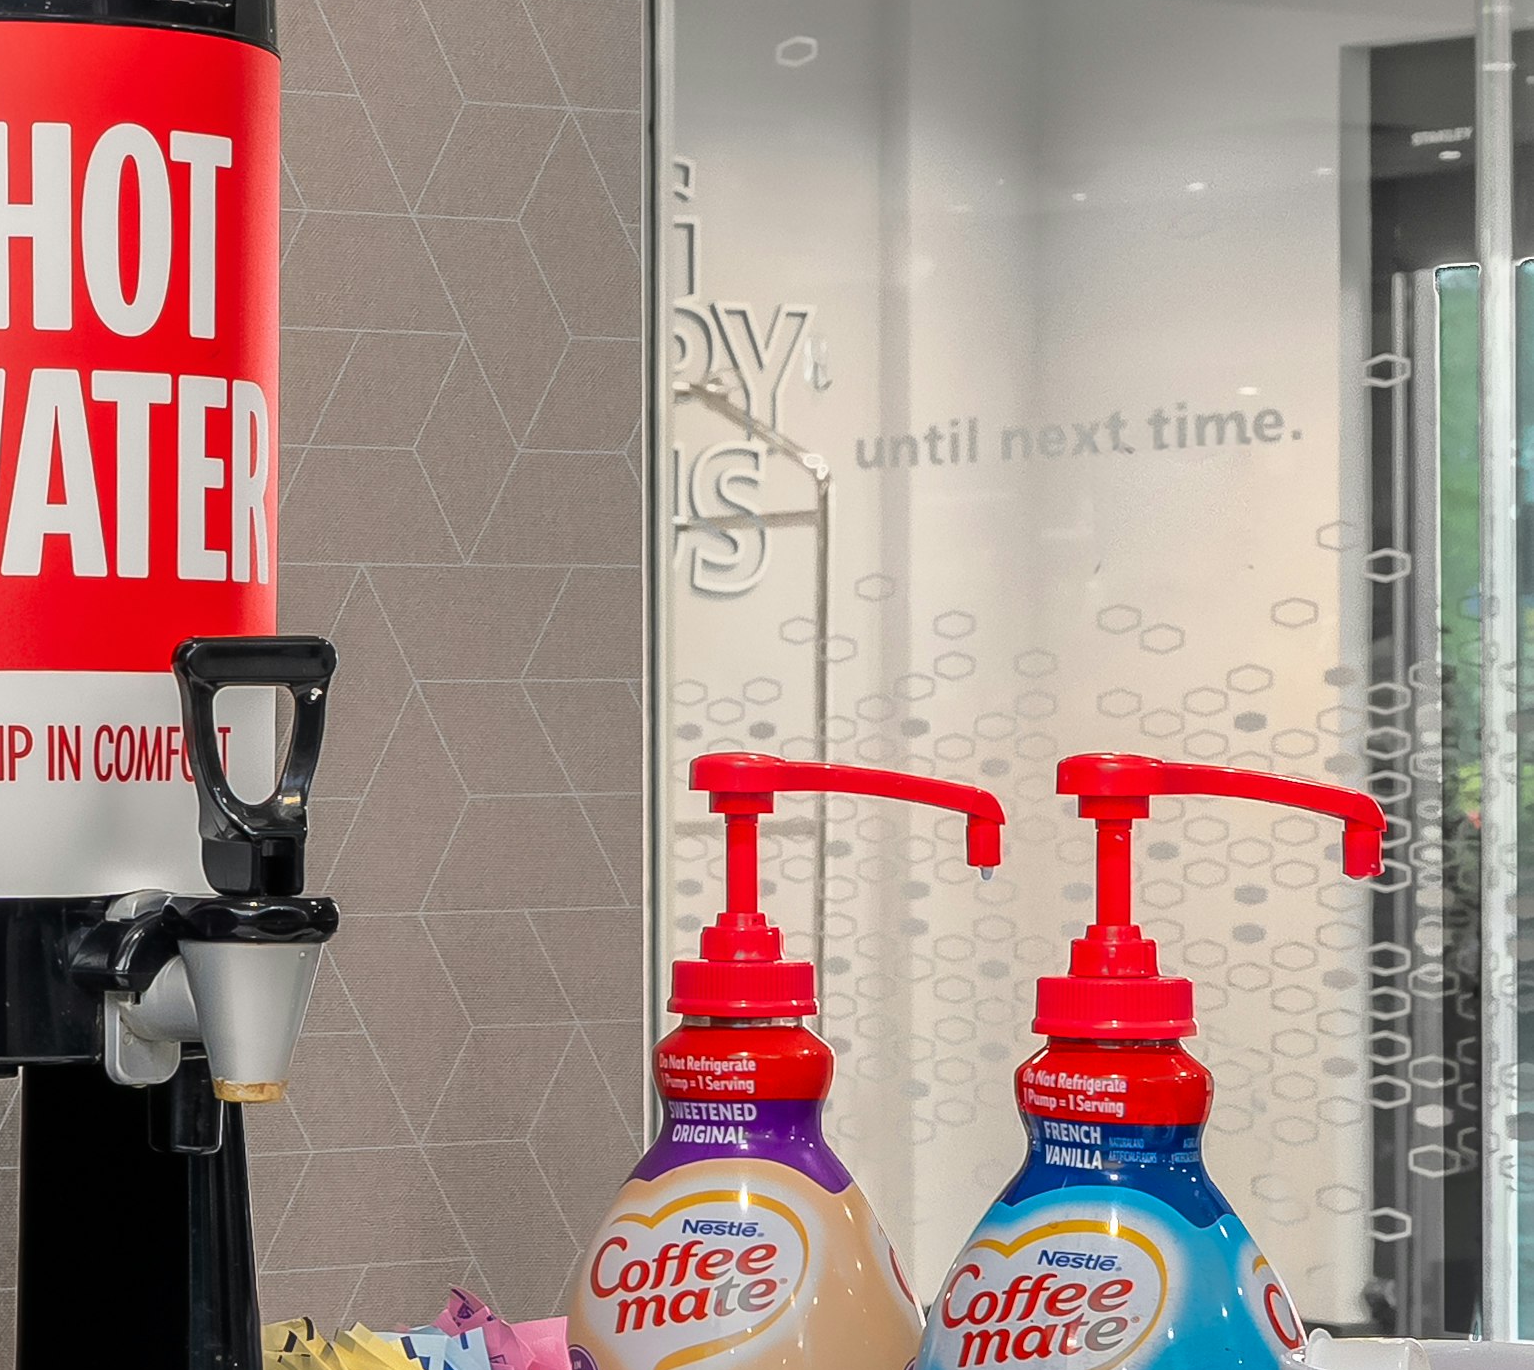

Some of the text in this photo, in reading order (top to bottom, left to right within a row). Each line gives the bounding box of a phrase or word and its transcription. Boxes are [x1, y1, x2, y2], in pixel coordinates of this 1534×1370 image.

[855, 400, 1304, 470] until next time.
[47, 725, 81, 781] IN
[96, 725, 231, 782] COMFT
[669, 1055, 685, 1070] Not
[687, 1056, 756, 1074] Refrigerate
[707, 1076, 755, 1094] Serving
[1034, 1070, 1055, 1086] Not
[1057, 1073, 1127, 1095] Refrigerate
[668, 1101, 757, 1121] SWEETENED
[1028, 1089, 1057, 1111] Pump
[1068, 1094, 1075, 1110] 1
[1076, 1095, 1125, 1118] Serving
[672, 1124, 748, 1144] ORIGINAL
[1043, 1121, 1101, 1145] FRENCH
[1045, 1144, 1103, 1170] VANILLA
[590, 1236, 777, 1299] Coffee
[615, 1276, 778, 1334] mate
[942, 1263, 1134, 1328] Coffee
[958, 1313, 1129, 1368] mate
